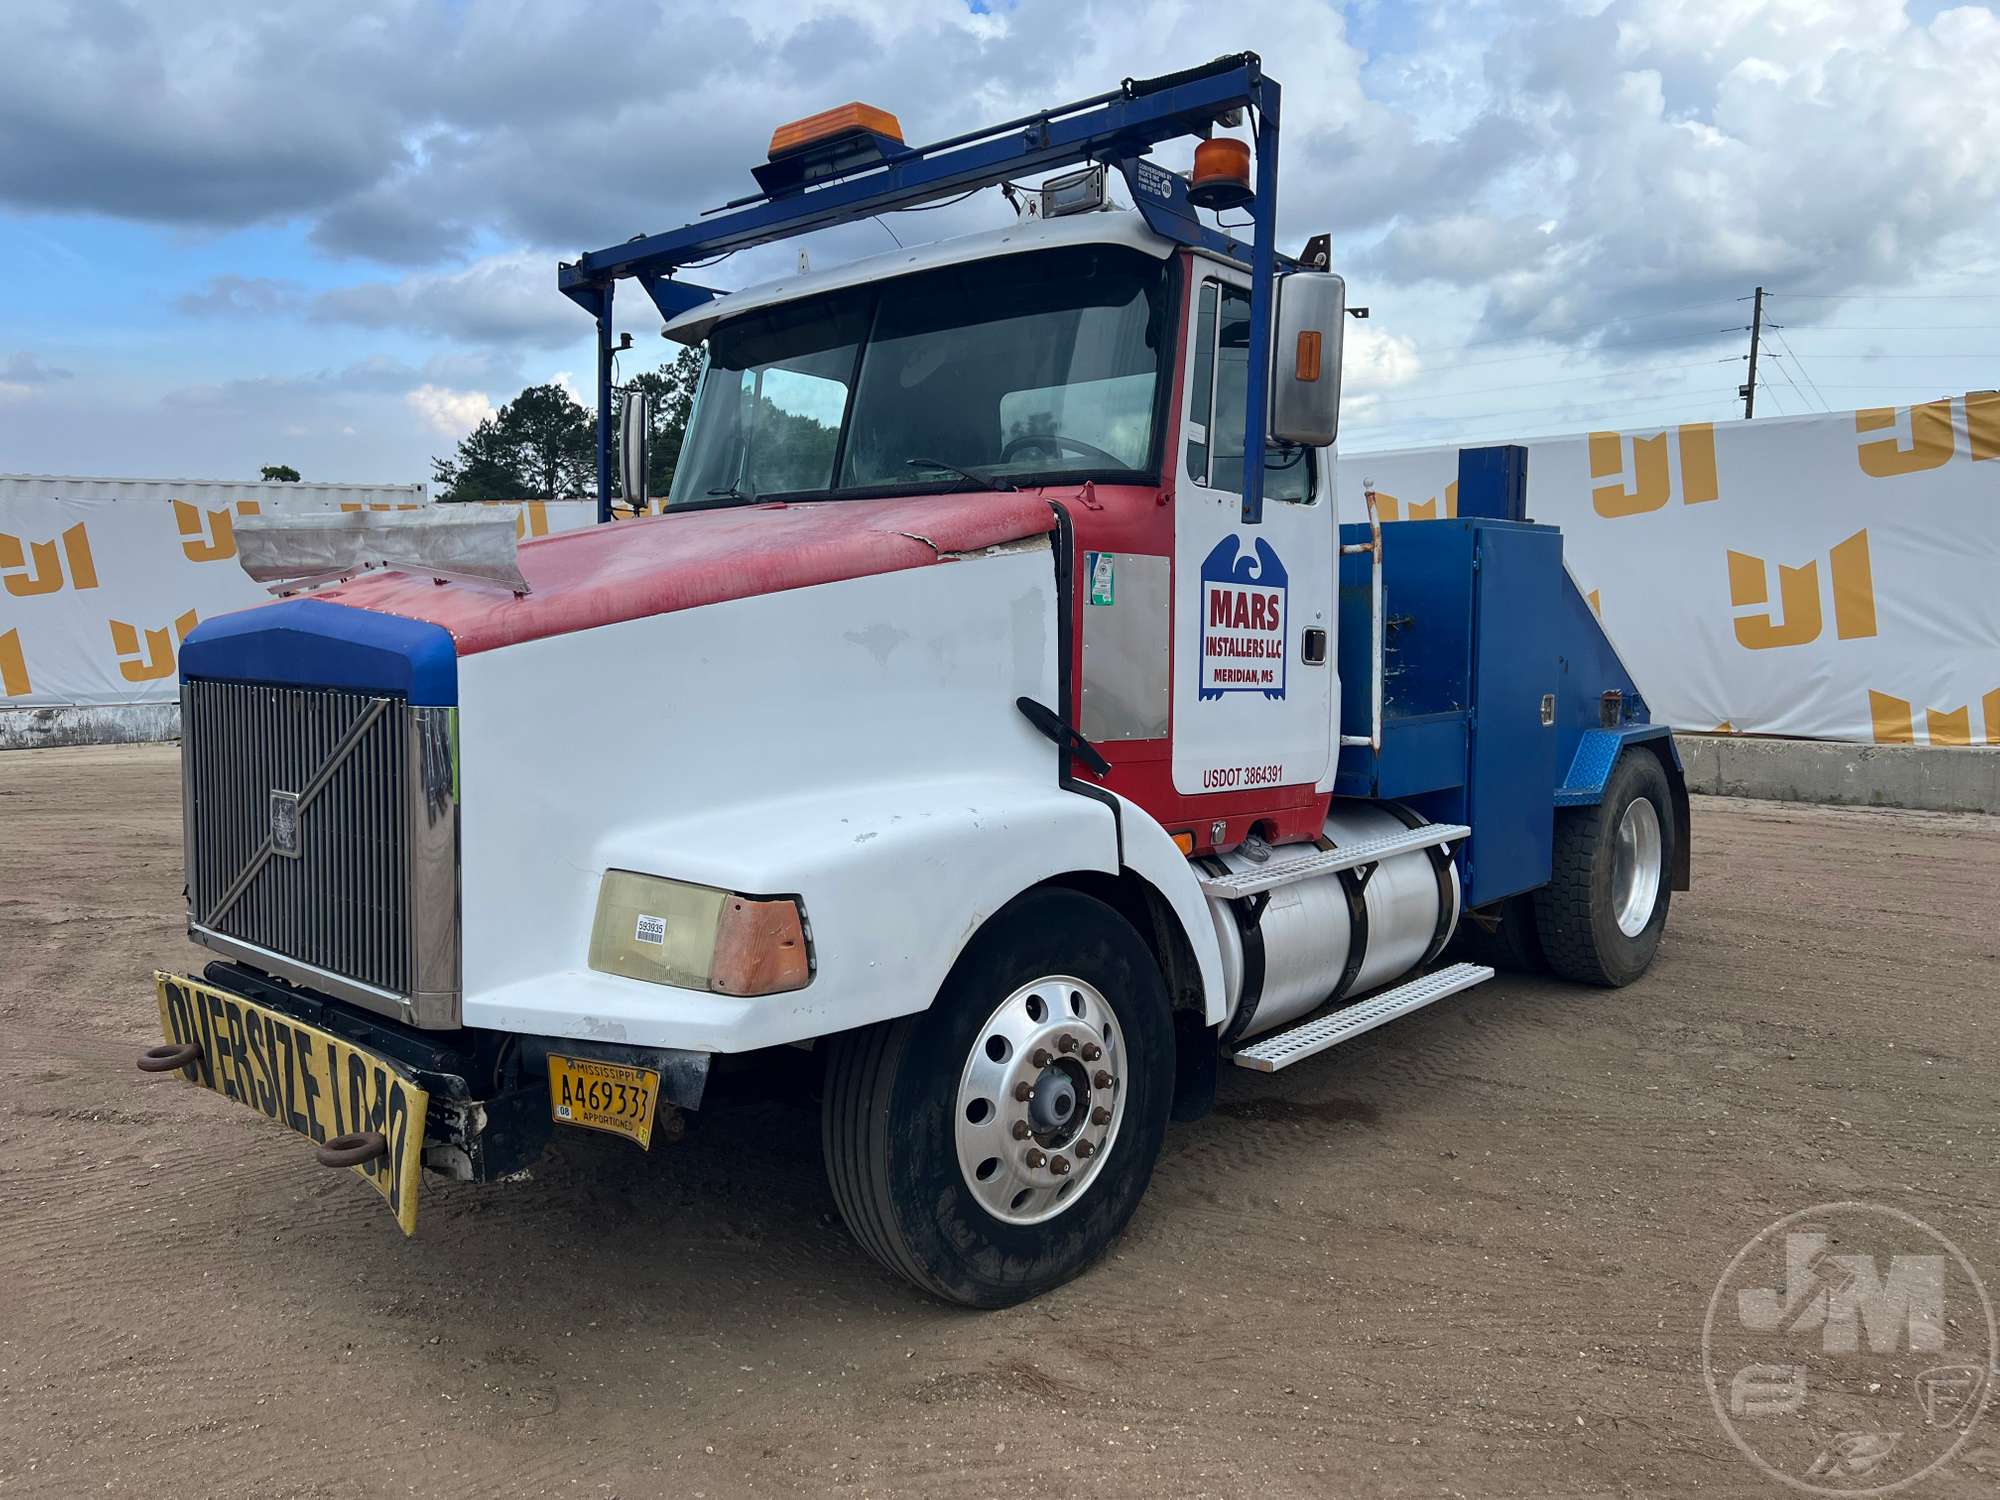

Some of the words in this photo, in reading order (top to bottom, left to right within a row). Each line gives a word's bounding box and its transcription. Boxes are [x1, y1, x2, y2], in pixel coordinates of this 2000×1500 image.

[1210, 589, 1280, 631] MARS
[1205, 636, 1265, 658] INSTALLERS
[1266, 639, 1282, 659] LLC
[1214, 668, 1260, 685] MERIDIAN,
[1261, 669, 1274, 683] MS
[1203, 767, 1242, 788] USDOT
[1244, 764, 1283, 785] 3864391
[639, 920, 664, 934] 593935
[165, 983, 326, 1145] OVERSIZE
[577, 1063, 635, 1081] MISSISSIPPI
[562, 1074, 648, 1122] A469333
[583, 1112, 634, 1131] APPORTIONED
